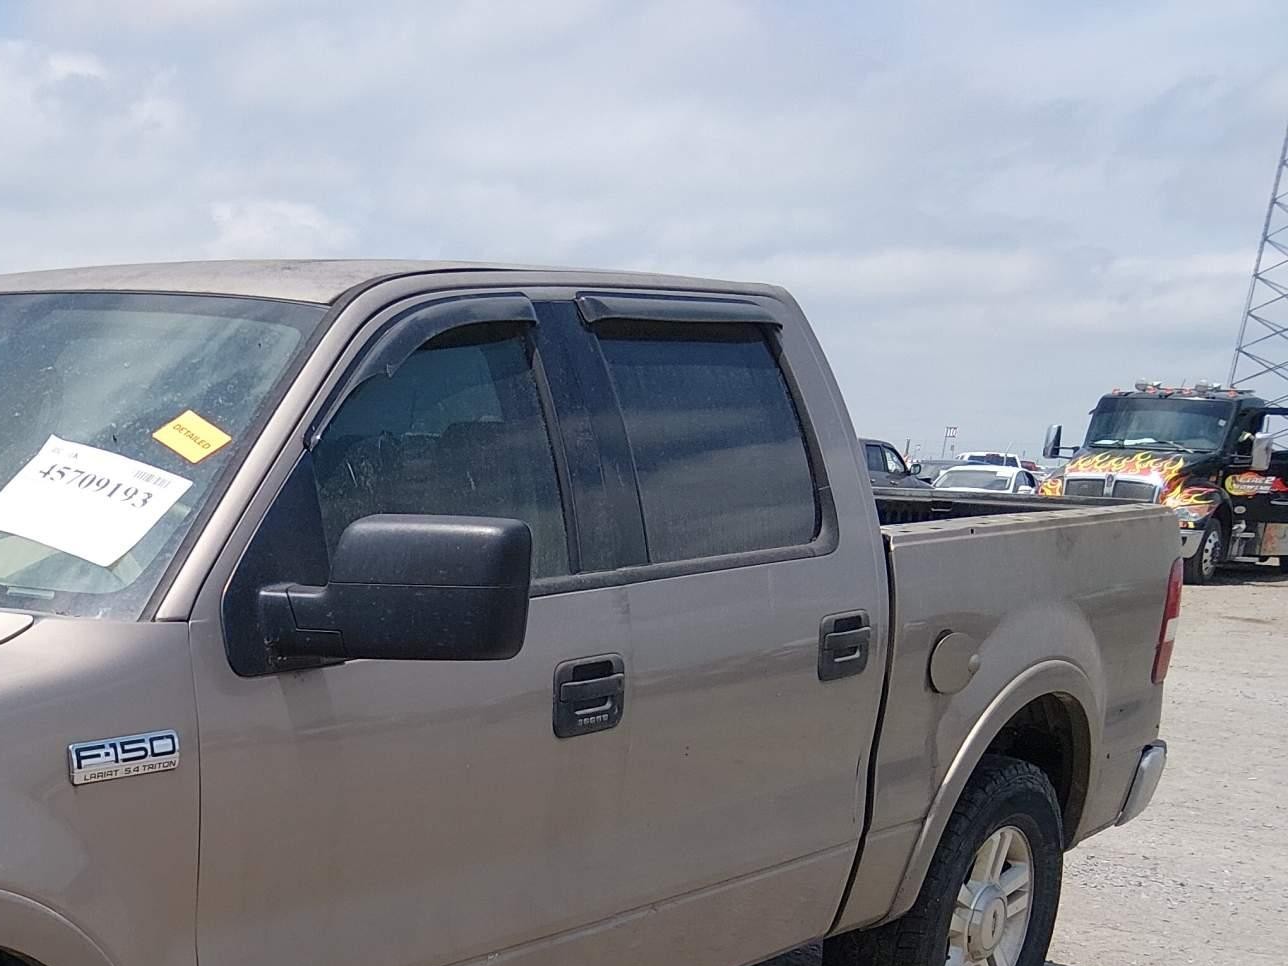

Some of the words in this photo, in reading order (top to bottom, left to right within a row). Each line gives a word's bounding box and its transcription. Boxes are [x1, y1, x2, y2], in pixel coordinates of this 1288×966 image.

[39, 463, 153, 508] 45709193
[75, 734, 177, 769] F-150
[83, 769, 120, 782] LARIAT
[142, 760, 177, 772] TRITON
